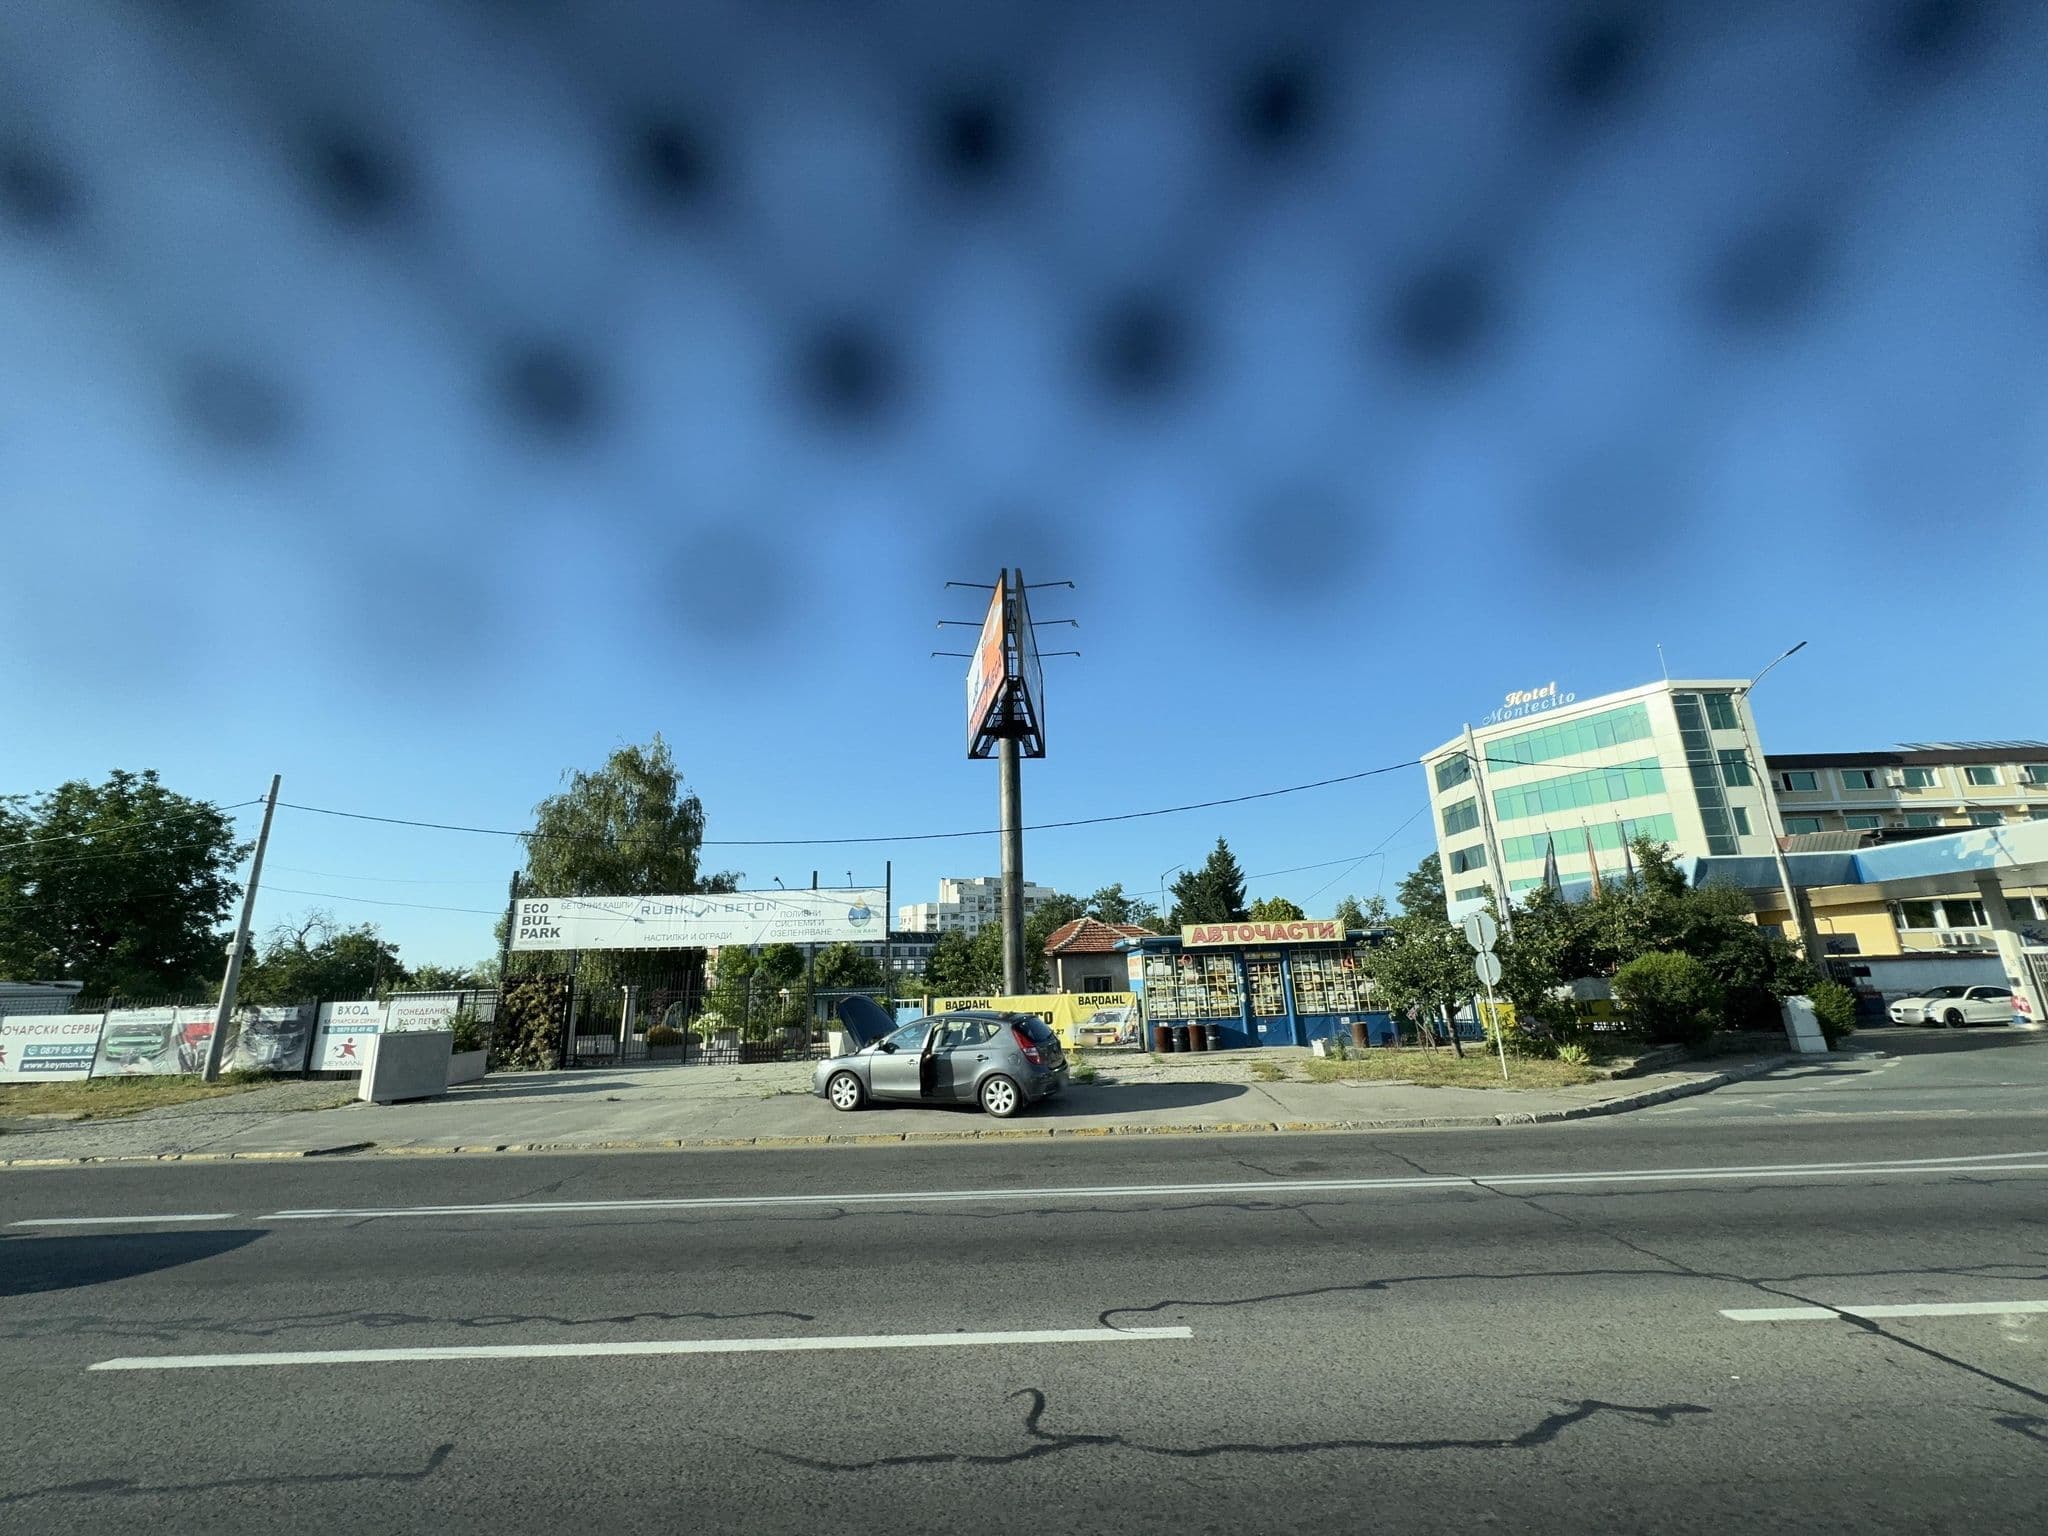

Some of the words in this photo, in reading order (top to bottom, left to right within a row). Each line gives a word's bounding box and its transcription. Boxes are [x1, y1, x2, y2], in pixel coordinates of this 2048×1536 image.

[1504, 681, 1556, 708] Hotel
[1482, 693, 1576, 726] Montecito
[523, 903, 549, 914] ECO
[603, 901, 634, 909] КАШПИ
[641, 902, 717, 916] RUBIKN
[725, 901, 777, 912] BETON
[522, 915, 552, 926] BUL
[775, 919, 818, 927] СИСТЕМИ
[519, 927, 561, 939] PARK
[643, 933, 689, 941] НАСТИЛКИ
[698, 931, 733, 940] ОГРАДИ
[770, 928, 833, 937] ОЗЕЛЕНЯВАНЕ
[1191, 922, 1337, 944] АВТОЧАСТИ
[945, 999, 993, 1010] BARDAHL
[1078, 995, 1126, 1007] BARDAHL
[337, 1004, 370, 1016] ВХОД
[40, 1046, 60, 1055] 0879
[61, 1046, 72, 1054] 05
[23, 1060, 92, 1070] www.keyman.bg
